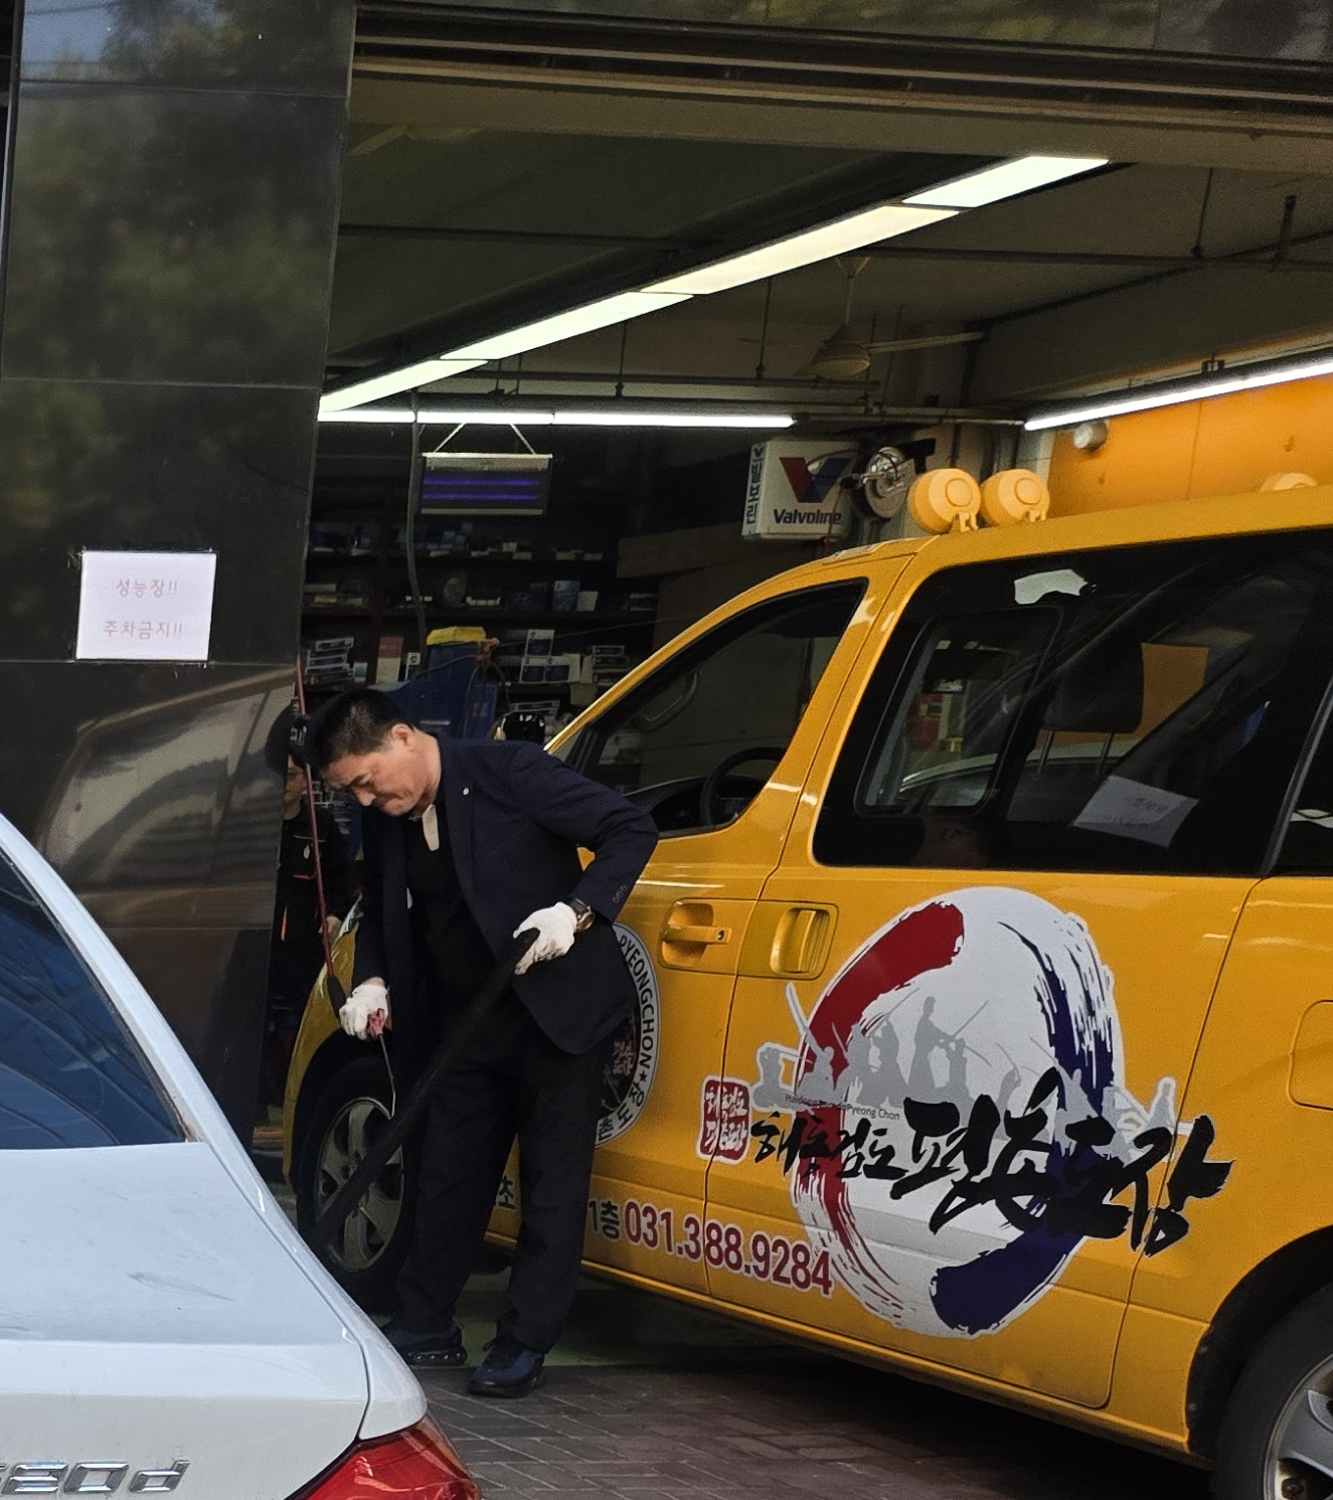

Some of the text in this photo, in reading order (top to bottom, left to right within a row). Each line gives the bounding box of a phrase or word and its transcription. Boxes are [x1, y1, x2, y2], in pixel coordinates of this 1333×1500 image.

[773, 508, 841, 525] Valvoline
[116, 578, 178, 598] 성능장!!
[103, 620, 183, 640] 주차금지!!
[625, 1201, 833, 1297] 031.388.9284
